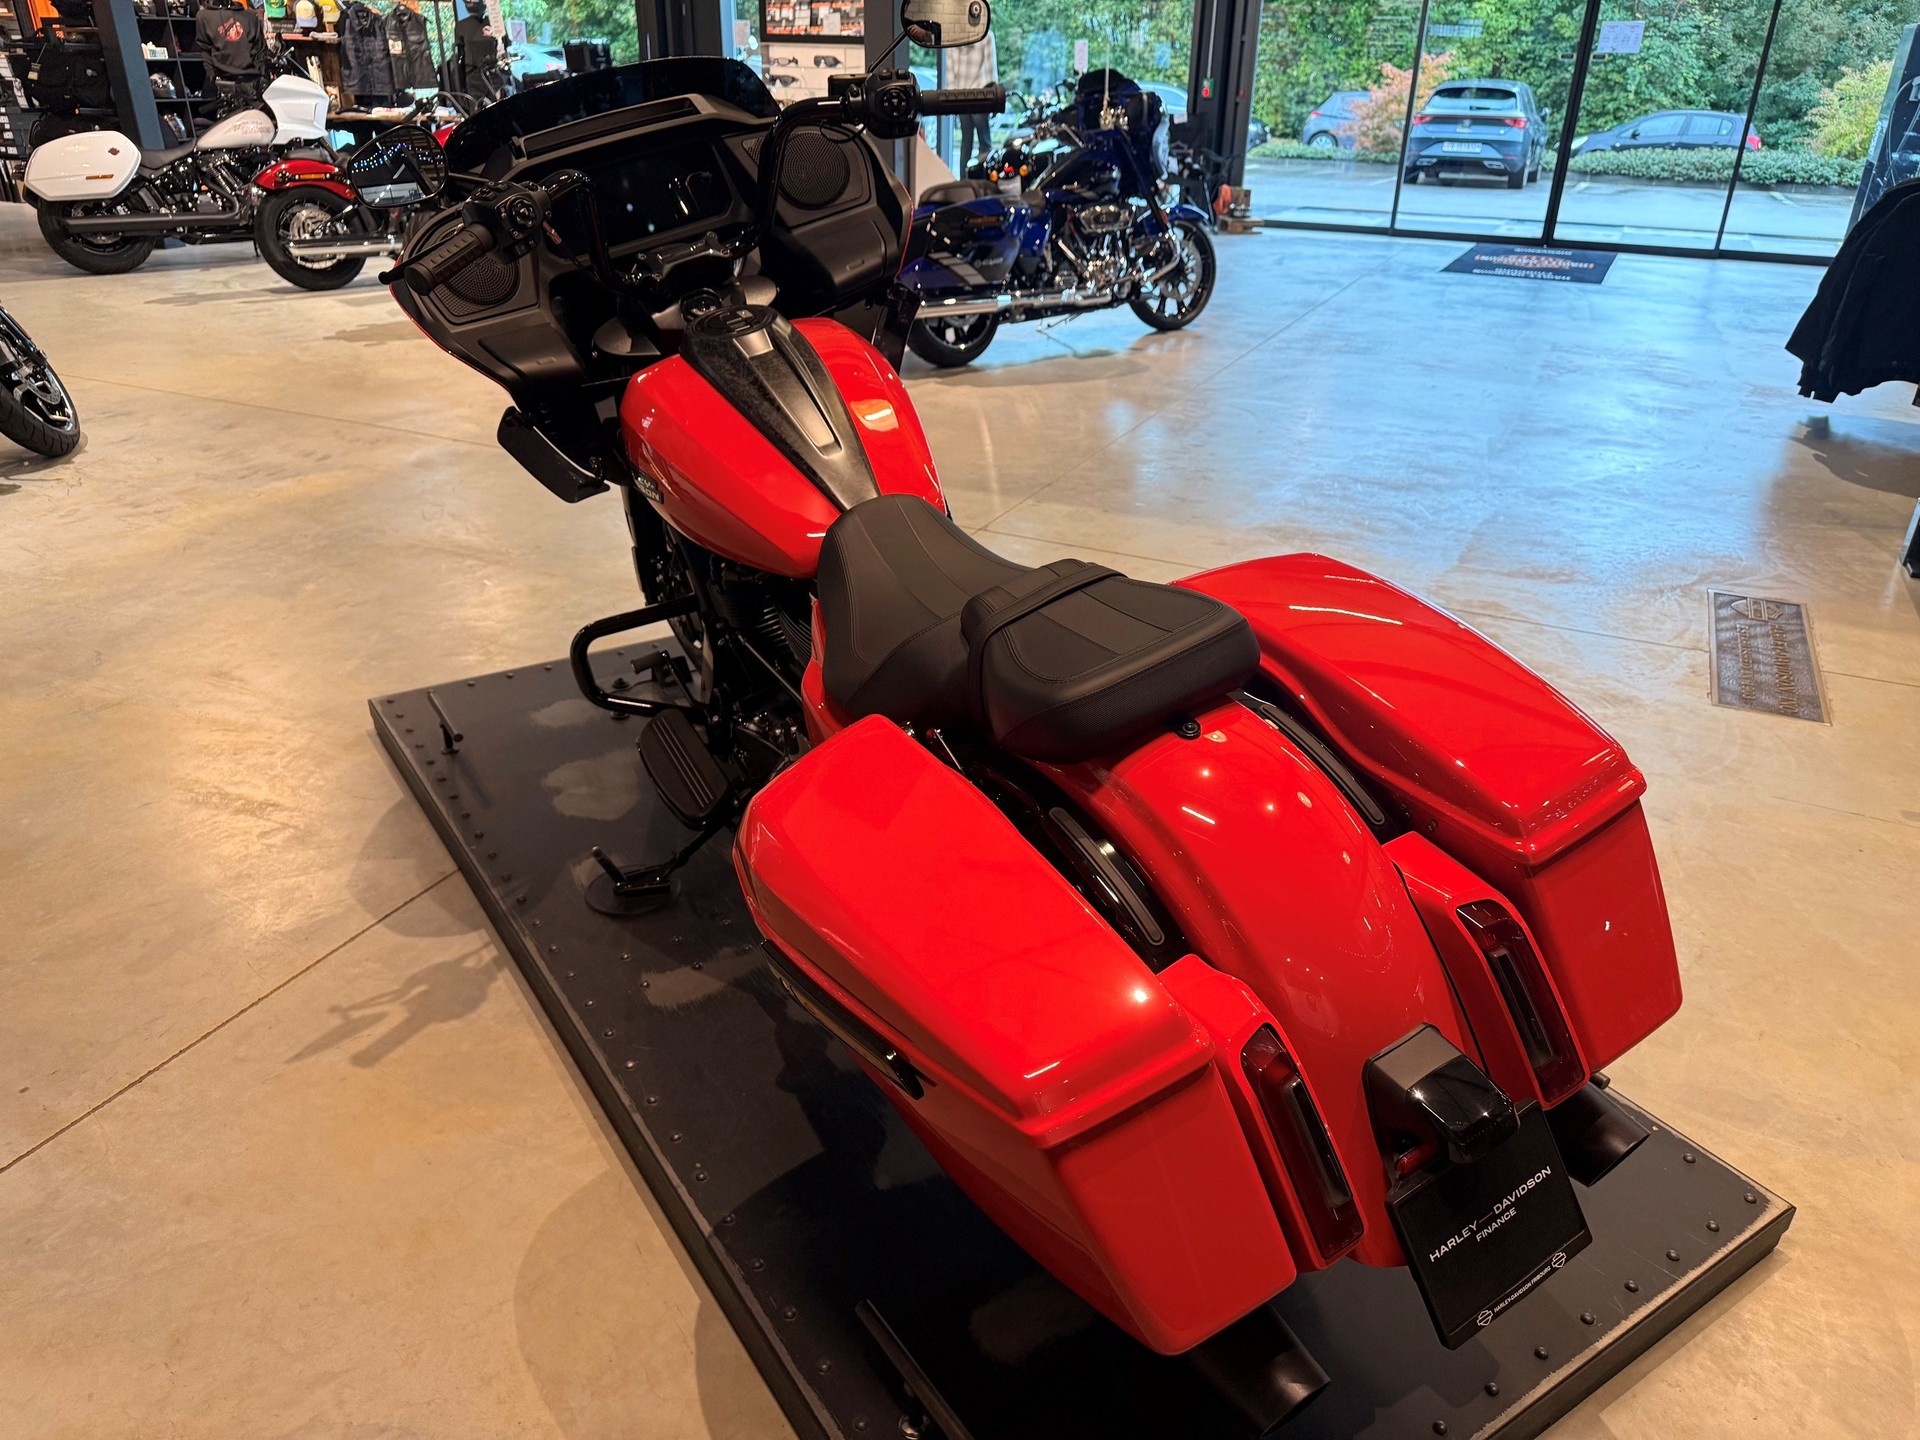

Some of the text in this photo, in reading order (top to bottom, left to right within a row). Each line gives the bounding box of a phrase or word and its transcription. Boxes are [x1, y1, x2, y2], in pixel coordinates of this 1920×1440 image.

[1476, 1207, 1517, 1242] FINANCE
[1494, 1265, 1551, 1312] HARLEY-DAVIDSON FRIBOURG
